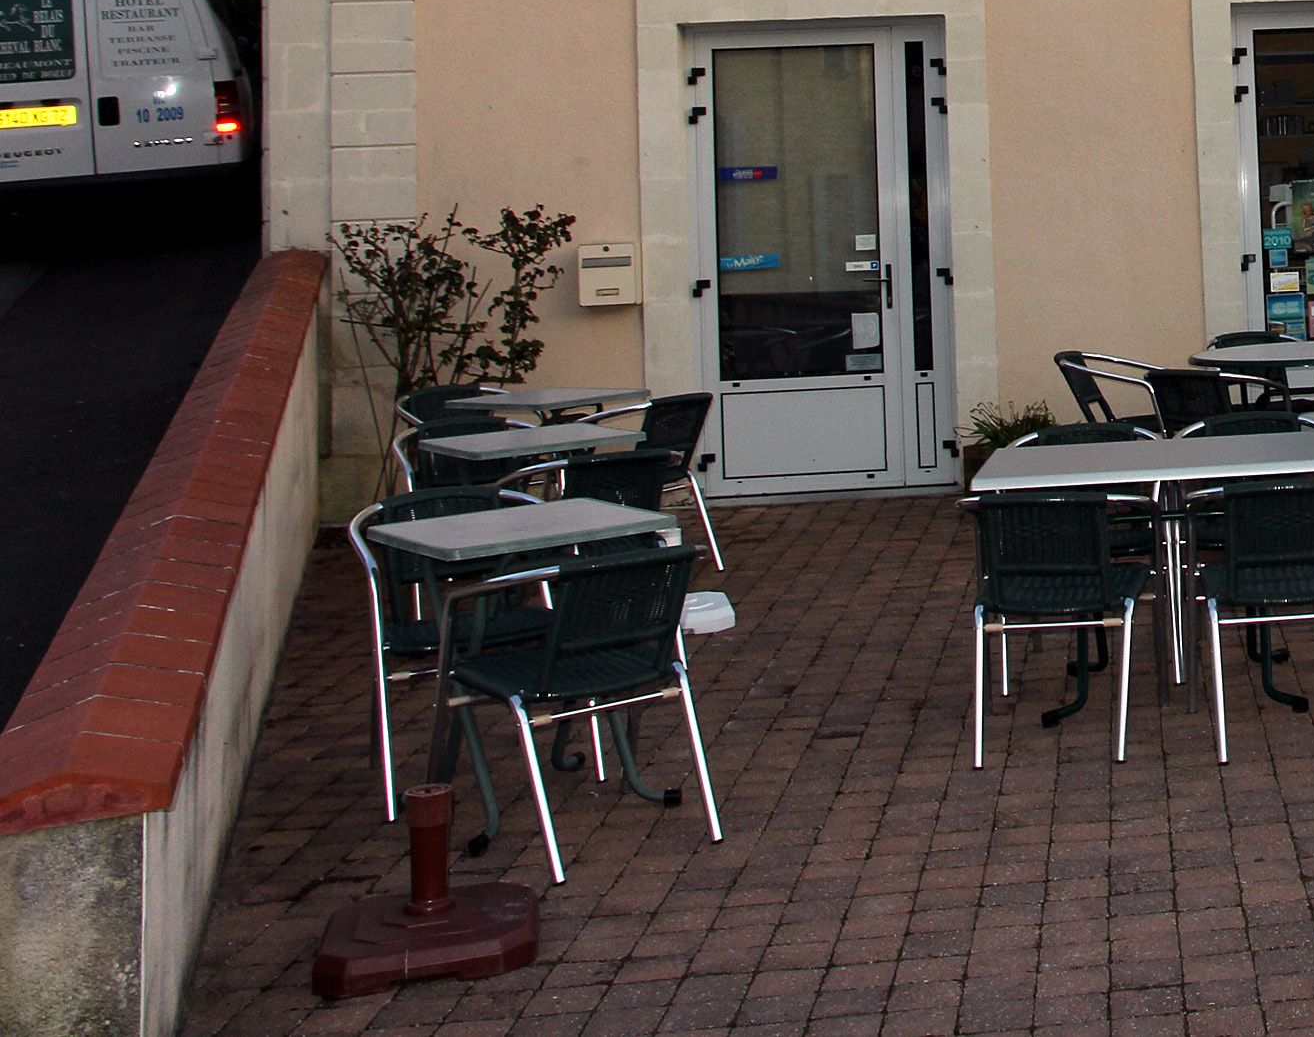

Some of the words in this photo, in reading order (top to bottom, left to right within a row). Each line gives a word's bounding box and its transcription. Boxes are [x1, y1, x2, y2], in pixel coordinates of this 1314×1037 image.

[33, 10, 63, 23] RELAIS
[101, 7, 179, 20] RESTAURANT
[41, 25, 55, 38] DU
[33, 39, 62, 52] BLANC
[110, 35, 176, 44] TERRASSE
[117, 47, 170, 55] PISCINE
[113, 58, 180, 67] TRAITEUR
[136, 108, 150, 123] 10
[157, 106, 184, 121] 2009
[0, 148, 63, 158] EUGEOT
[1264, 235, 1292, 246] 2010
